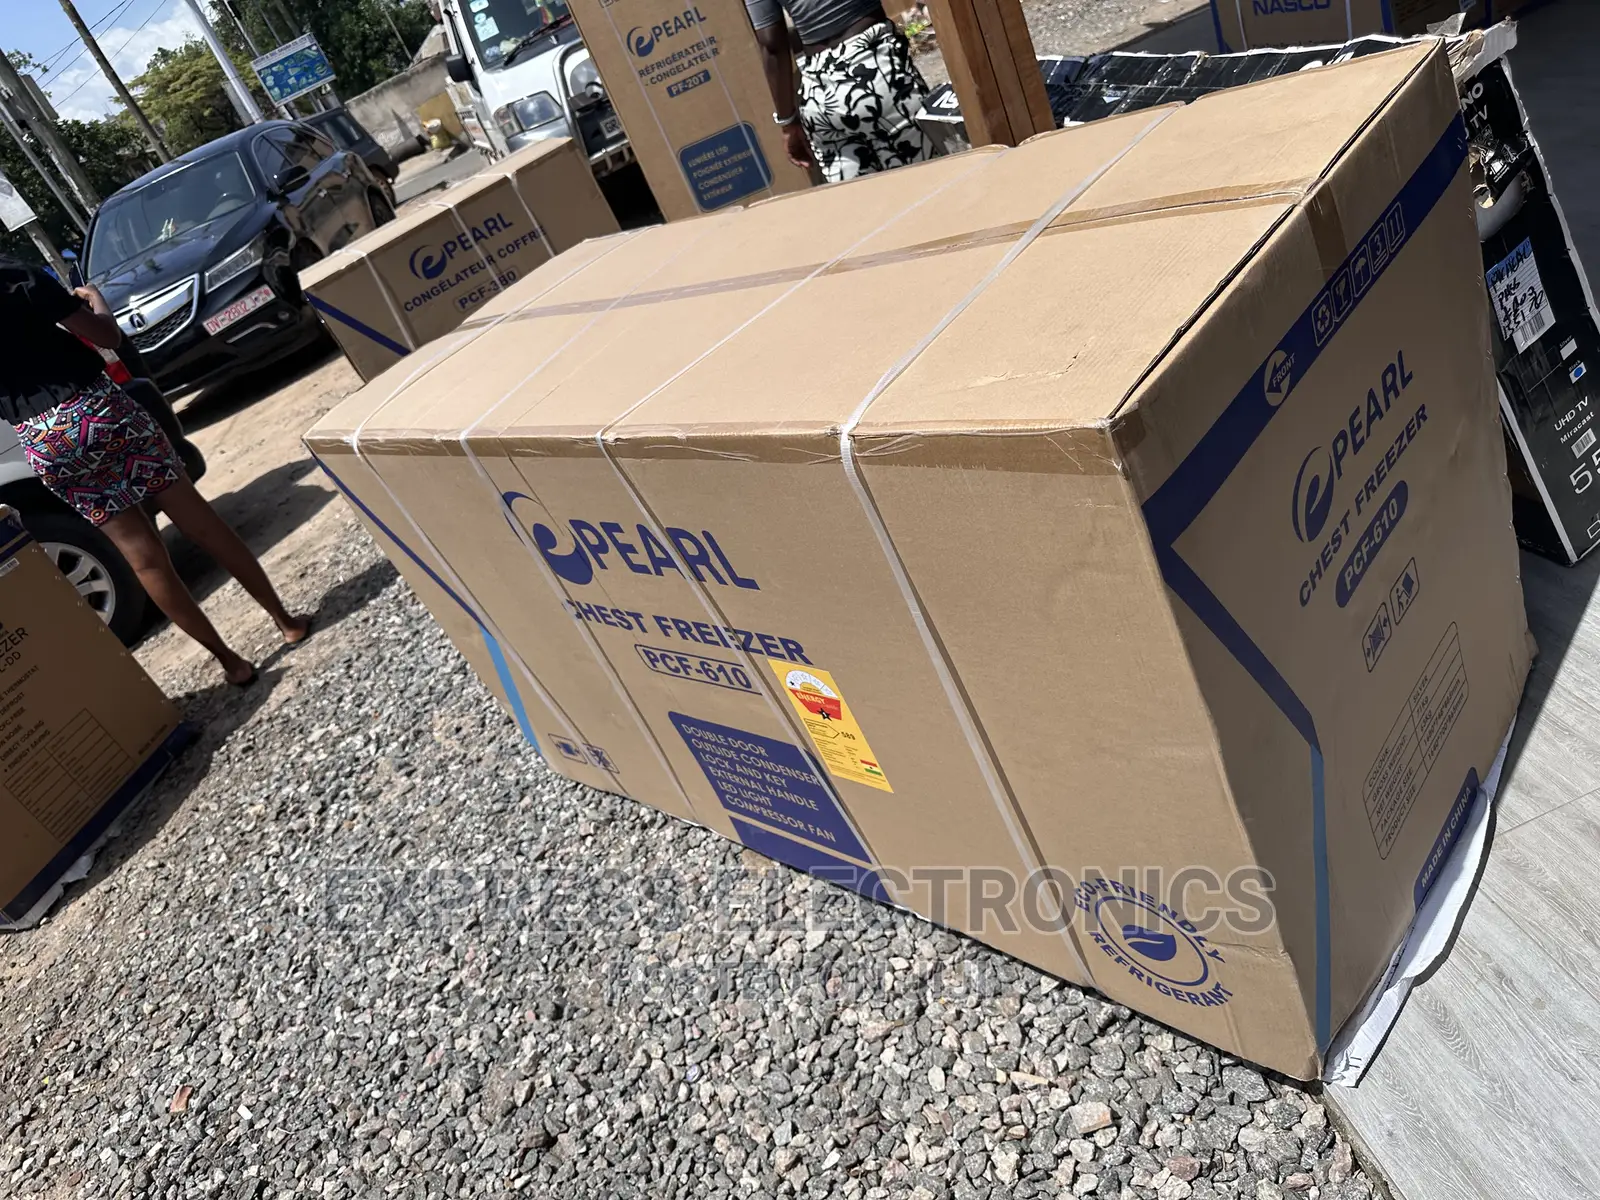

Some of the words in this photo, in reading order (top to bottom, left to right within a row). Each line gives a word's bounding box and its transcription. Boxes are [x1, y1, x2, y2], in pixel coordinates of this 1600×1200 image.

[652, 6, 707, 43] PEARL
[638, 36, 717, 78] RÉFRIGÉRATEUR
[1470, 104, 1488, 129] TV
[442, 212, 514, 260] PEARL
[404, 254, 497, 312] CONGÉLATEUR
[1272, 352, 1297, 388] FRONT
[1332, 350, 1414, 481] PEARL
[1554, 408, 1577, 432] UHD
[1575, 396, 1589, 412] TV
[1560, 411, 1595, 445] Miracast
[1299, 508, 1351, 608] CHEST
[1354, 403, 1429, 517] FREEZER
[568, 518, 761, 591] PEARL
[1343, 496, 1399, 593] PCF-610
[652, 614, 814, 666] FREEZER
[4, 664, 40, 697] THERMOSTAT
[642, 648, 753, 690] PCF-610
[681, 723, 730, 747] DOUBLE
[728, 737, 770, 758] DOOR
[691, 738, 739, 762] OUTSIDE
[739, 752, 822, 787] CONDENSER
[700, 752, 735, 772] LOCK
[736, 763, 762, 781] AND
[764, 772, 788, 788] KEY
[708, 766, 765, 794] EXTERNAL
[767, 786, 820, 812] HANDLE
[717, 780, 738, 795] LED
[740, 786, 773, 808] LIGHT
[725, 795, 807, 832] COMPRESSOR
[807, 825, 838, 844] FAN
[1420, 845, 1444, 888] MADE
[1442, 828, 1452, 848] IN
[1450, 786, 1472, 830] CHINA
[1073, 877, 1226, 964] ECO-FRIENDLY
[1088, 931, 1234, 1007] REFRIGERANT
